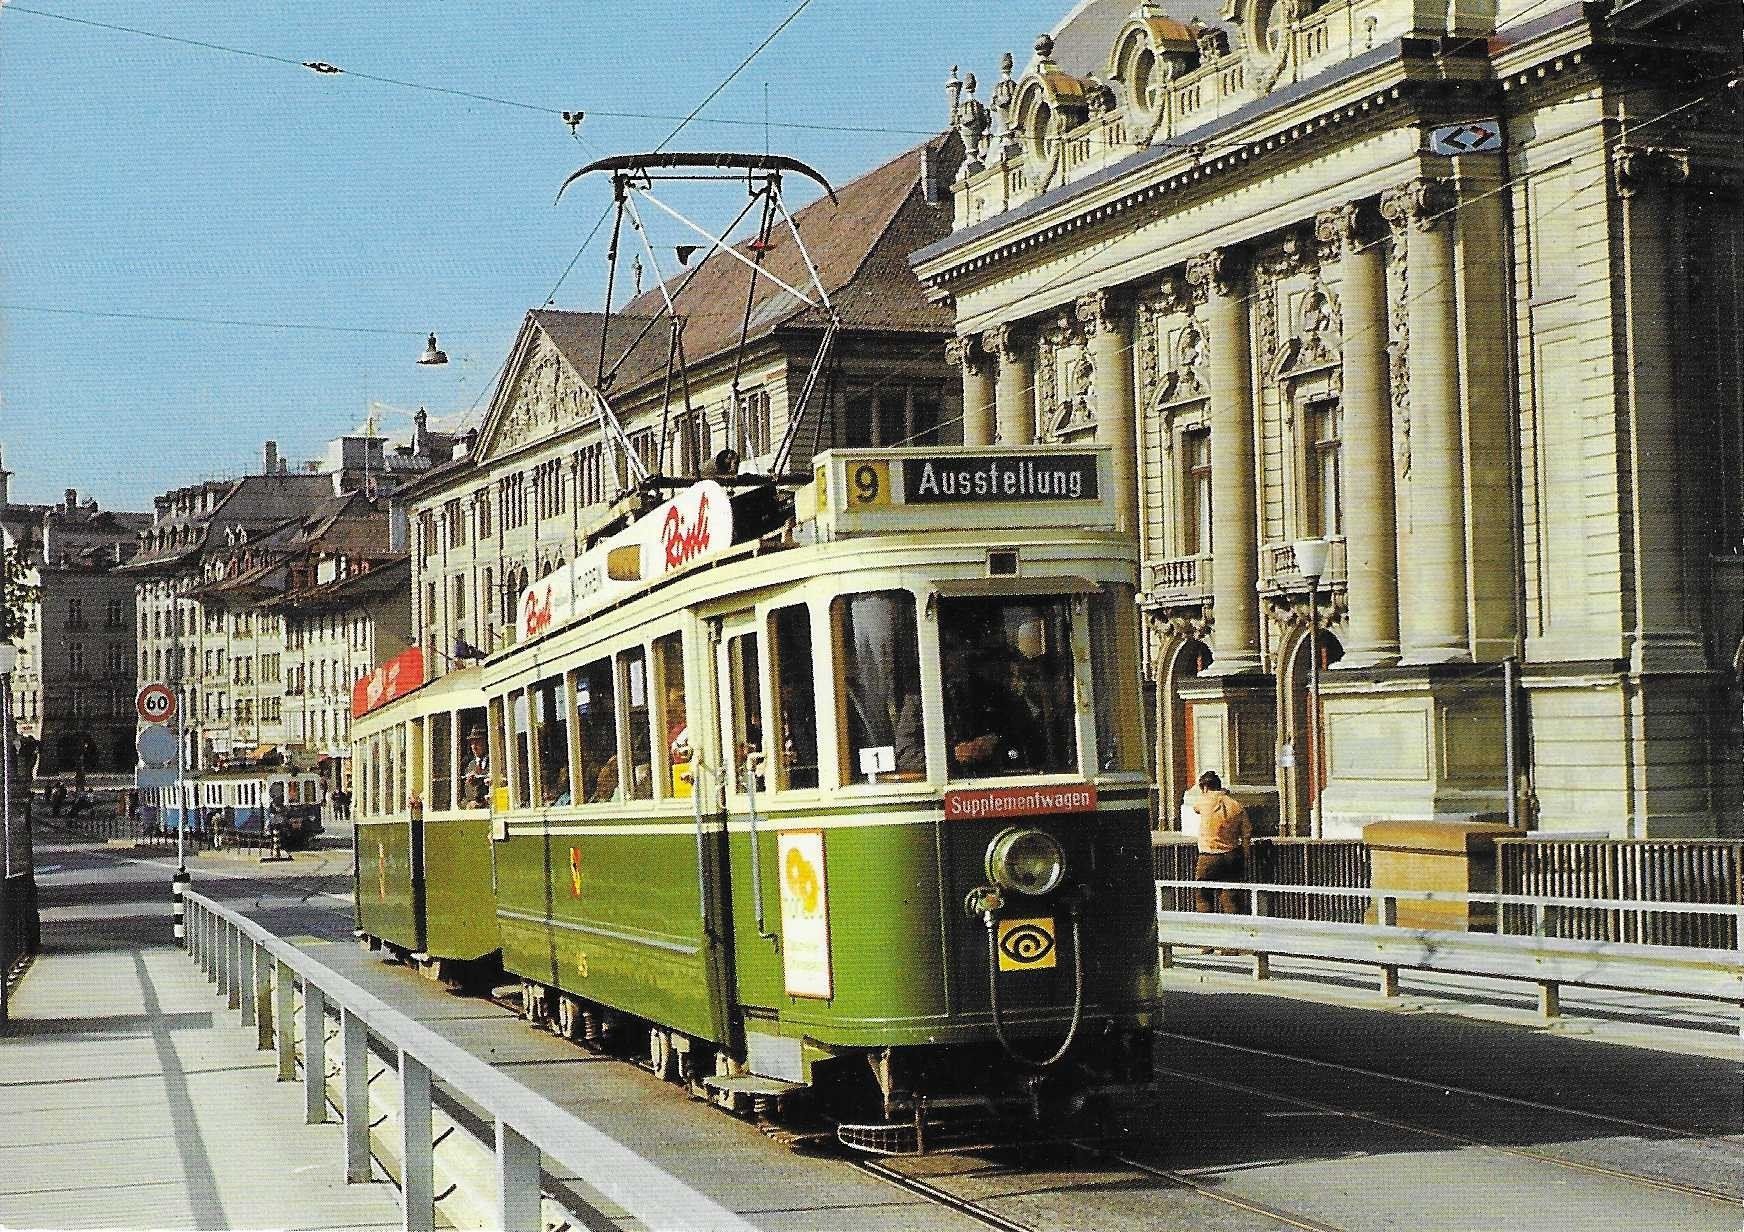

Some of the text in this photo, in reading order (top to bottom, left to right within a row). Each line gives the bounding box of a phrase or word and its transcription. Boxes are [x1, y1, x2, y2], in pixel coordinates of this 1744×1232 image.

[854, 465, 879, 502] 9
[918, 462, 1083, 499] Ausstellung
[146, 695, 167, 711] 60
[872, 752, 881, 769] 1
[951, 791, 1091, 816] Supplementwagen
